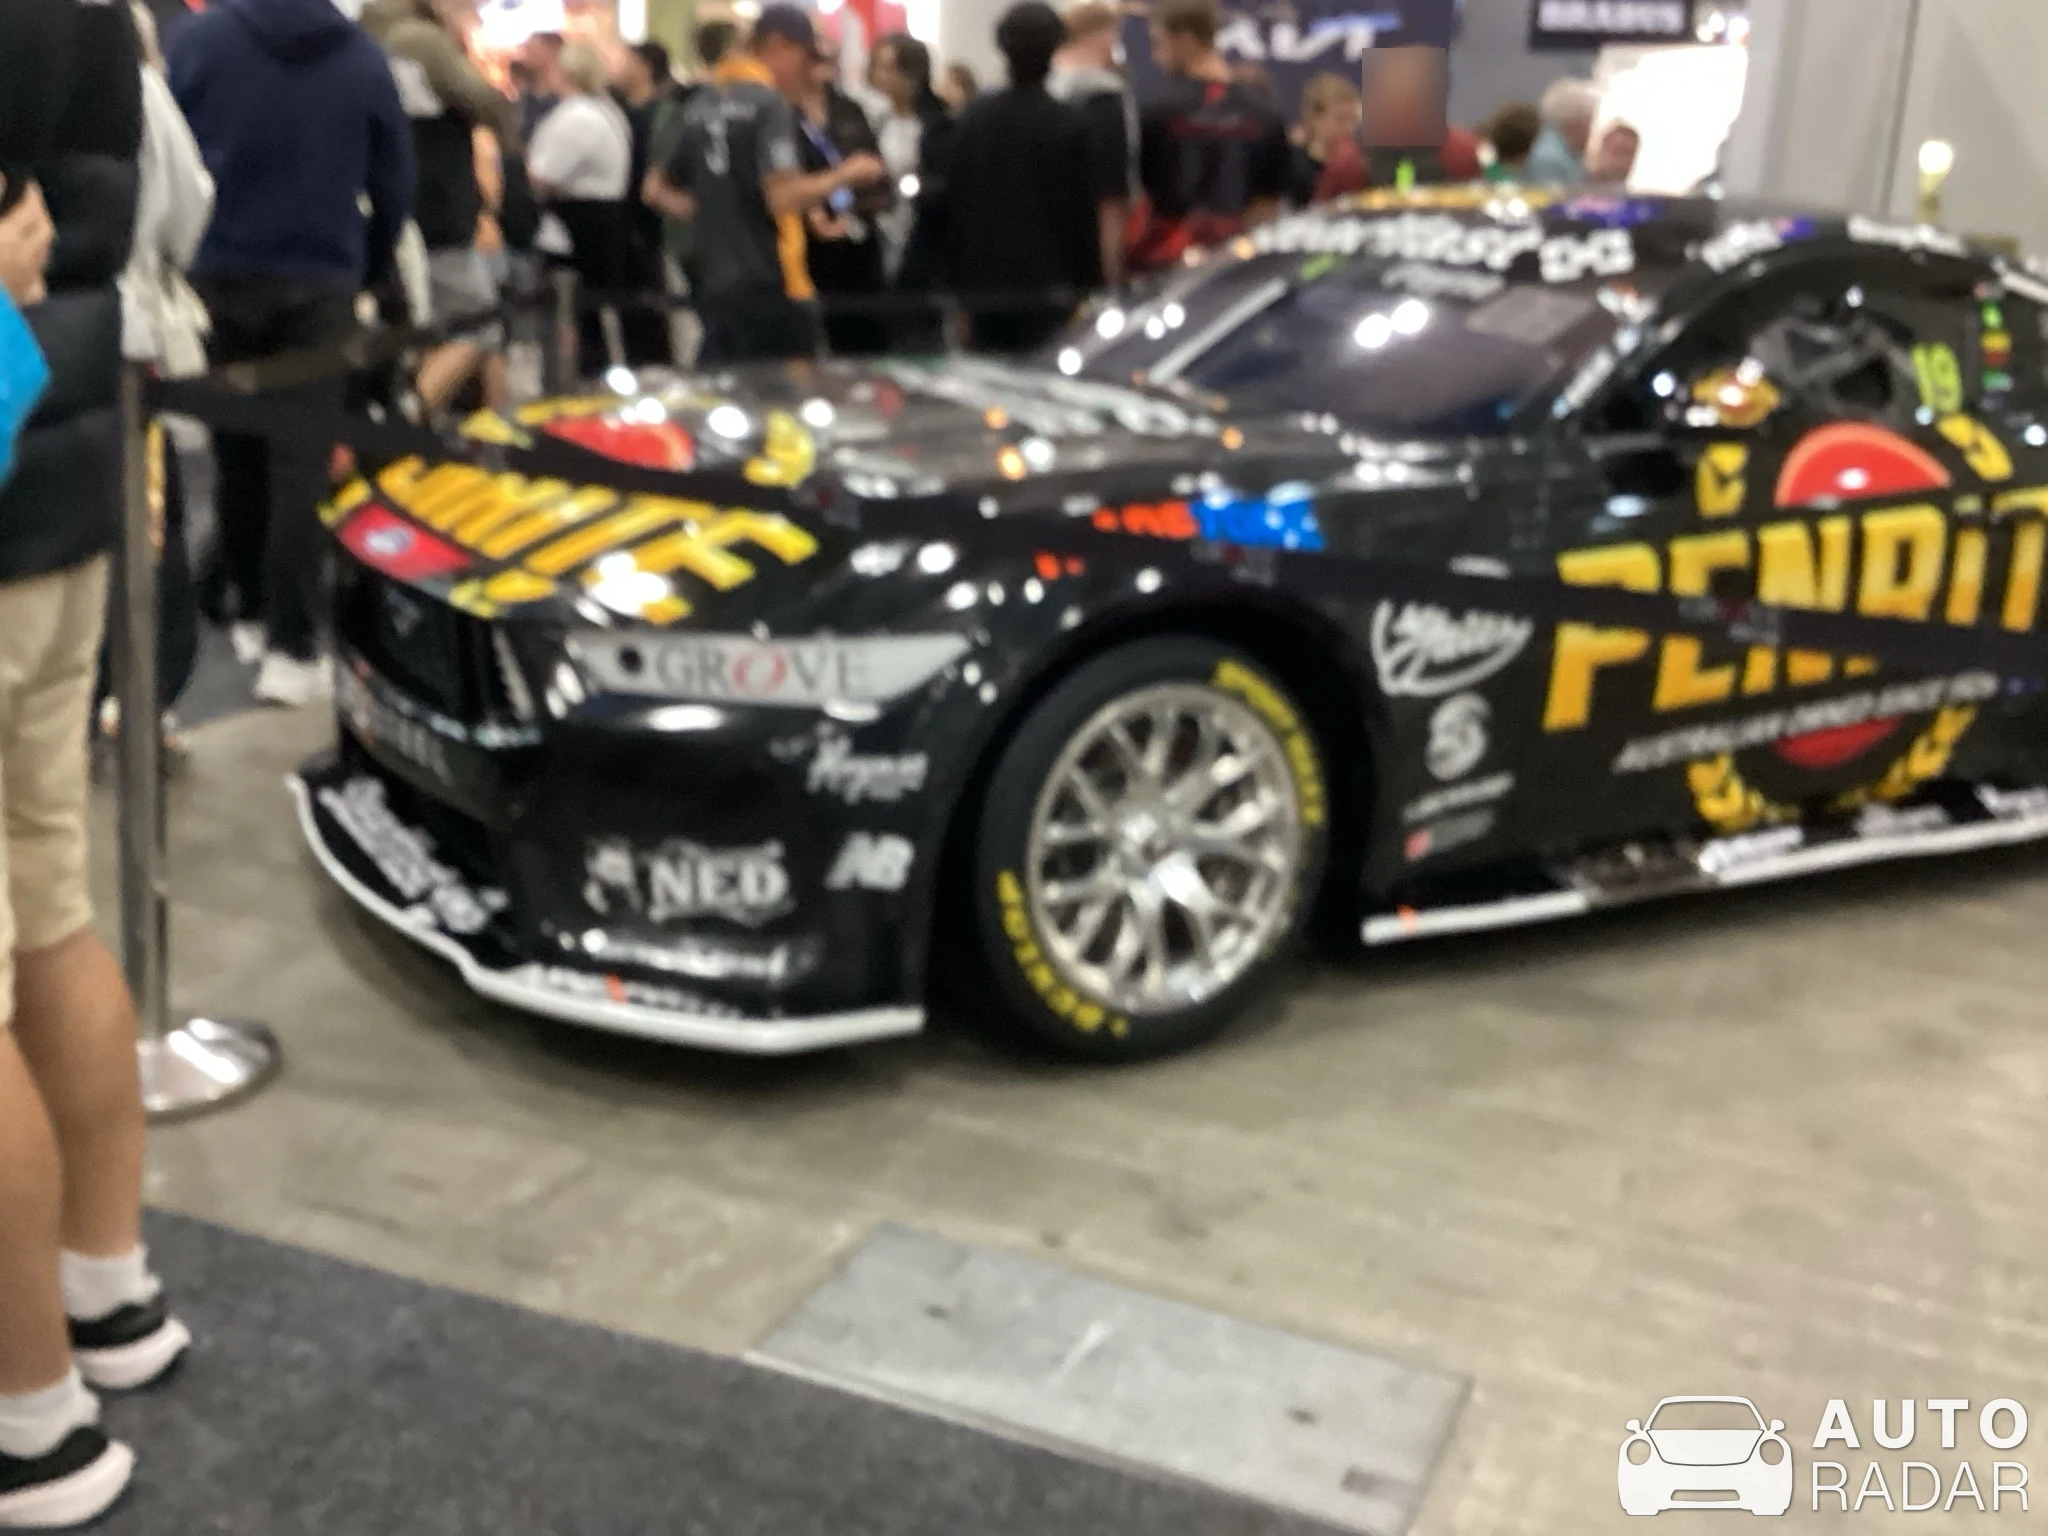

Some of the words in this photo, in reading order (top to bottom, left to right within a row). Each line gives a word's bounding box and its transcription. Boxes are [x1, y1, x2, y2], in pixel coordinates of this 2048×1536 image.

[1911, 342, 1963, 415] 19
[655, 642, 868, 698] GROVE
[651, 850, 790, 907] NED
